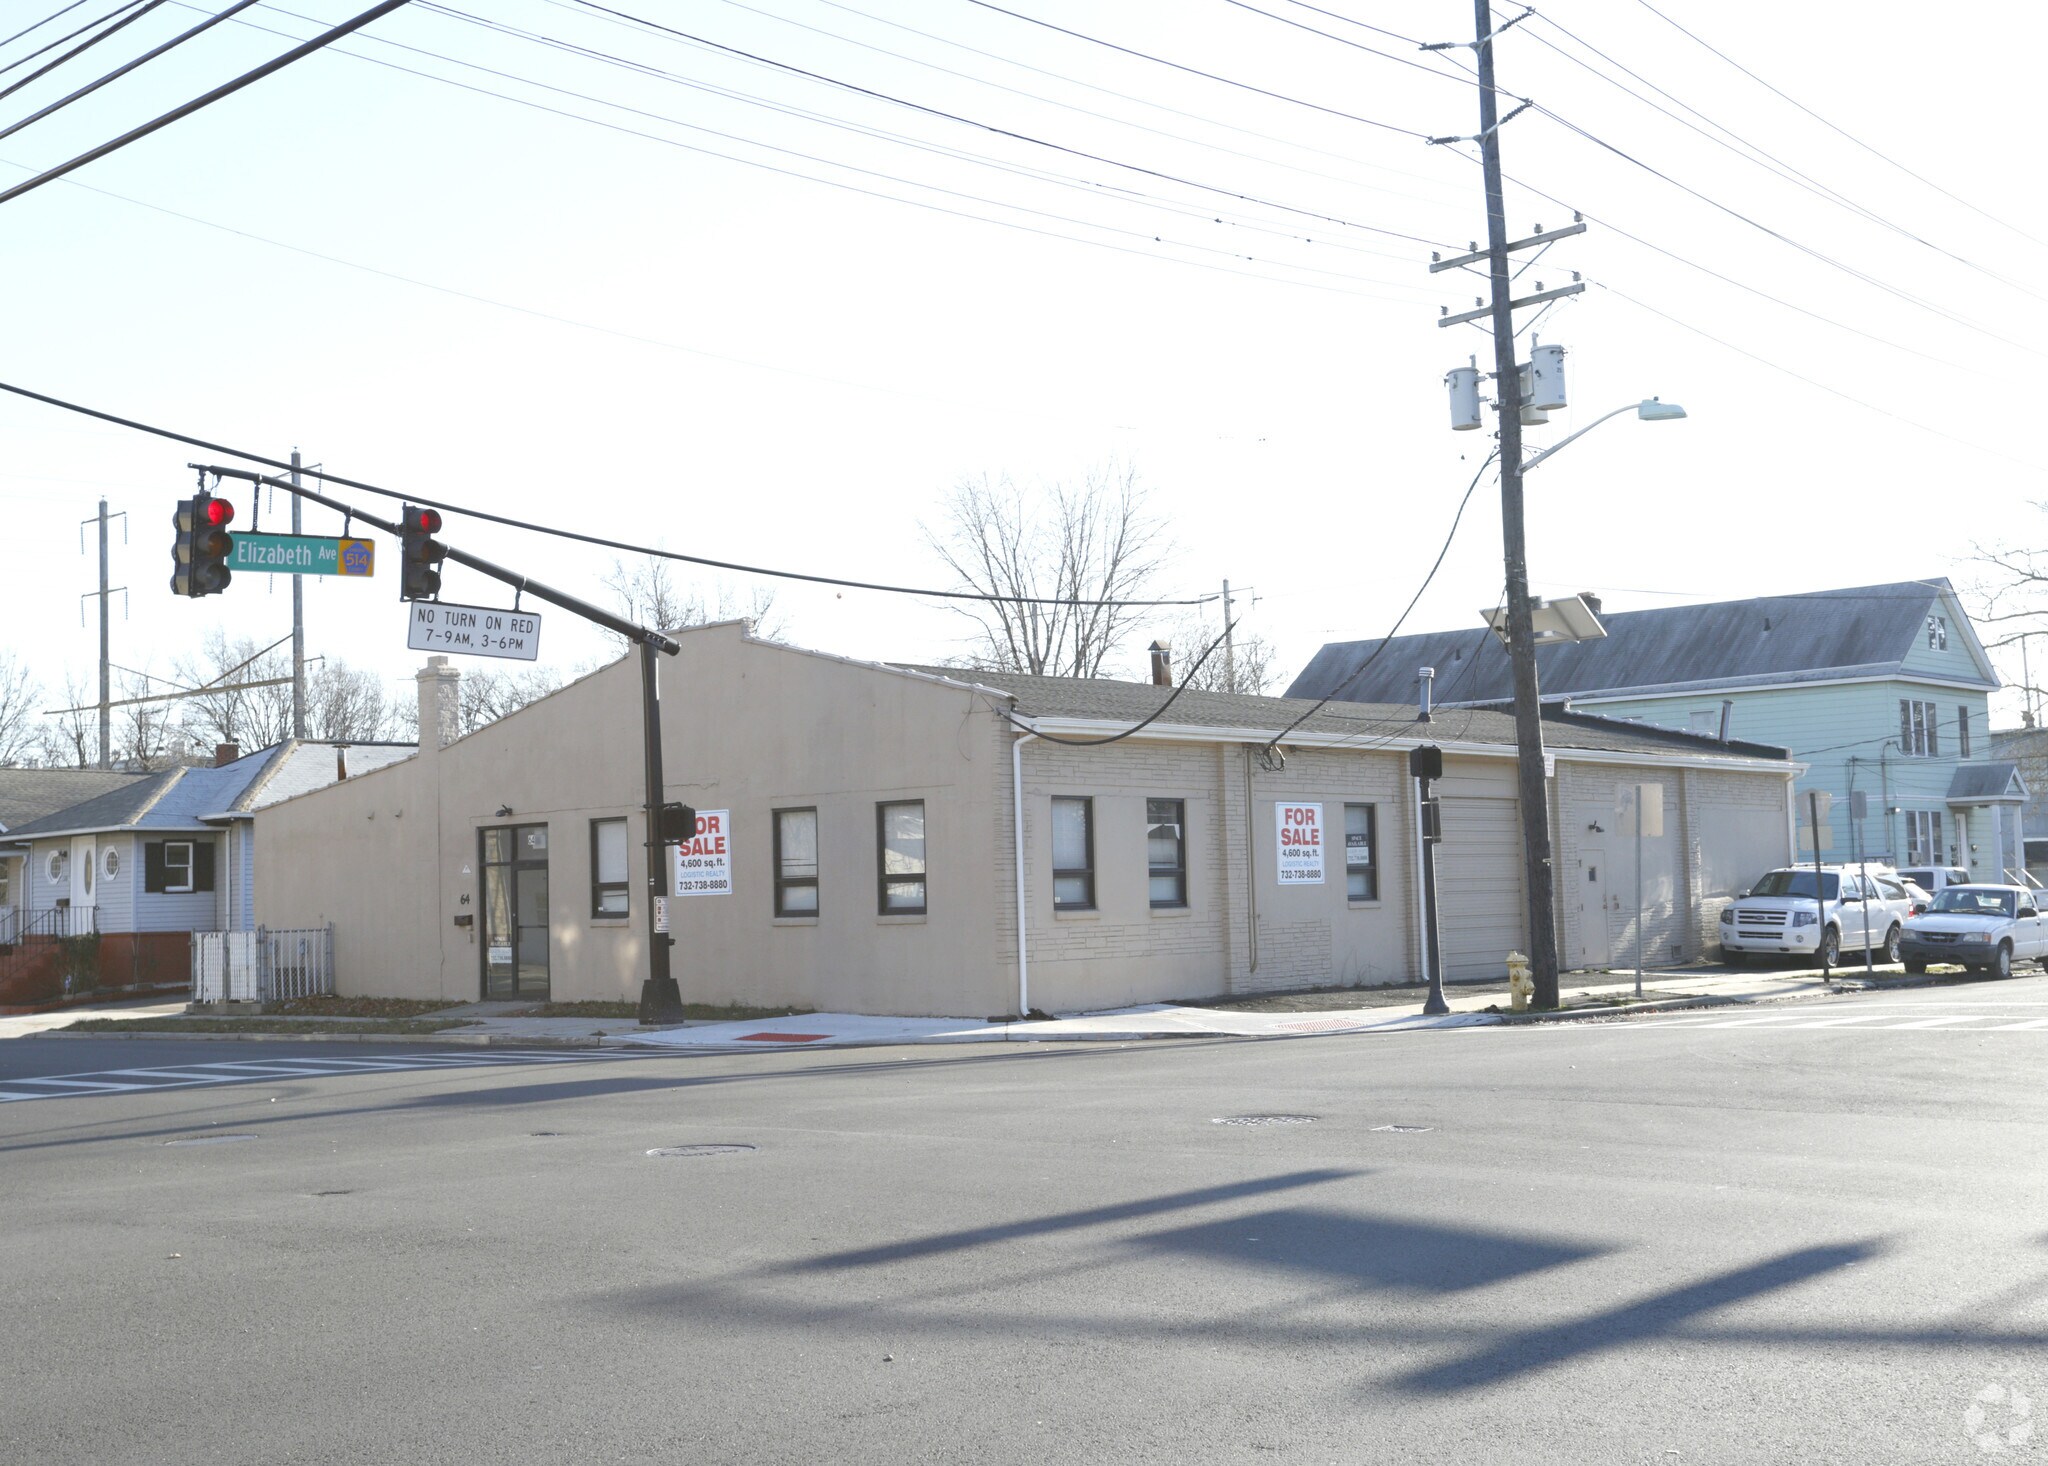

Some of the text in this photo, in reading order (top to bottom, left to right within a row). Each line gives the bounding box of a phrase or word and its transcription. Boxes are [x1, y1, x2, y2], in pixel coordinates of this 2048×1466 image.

[238, 541, 337, 566] Elizabeth Ave
[345, 553, 369, 567] 514
[417, 608, 534, 634] NO TURN ON RED
[481, 634, 524, 650] 3-6PM
[695, 816, 720, 834] OR
[1284, 808, 1315, 826] FOR
[1280, 828, 1320, 846] SALE
[679, 837, 726, 856] SALE
[1282, 849, 1300, 858] 4,600
[680, 859, 702, 869] 4,600
[1281, 869, 1321, 879] 732-738-8880
[679, 879, 728, 891] 732-738-8880
[460, 894, 470, 905] 64
